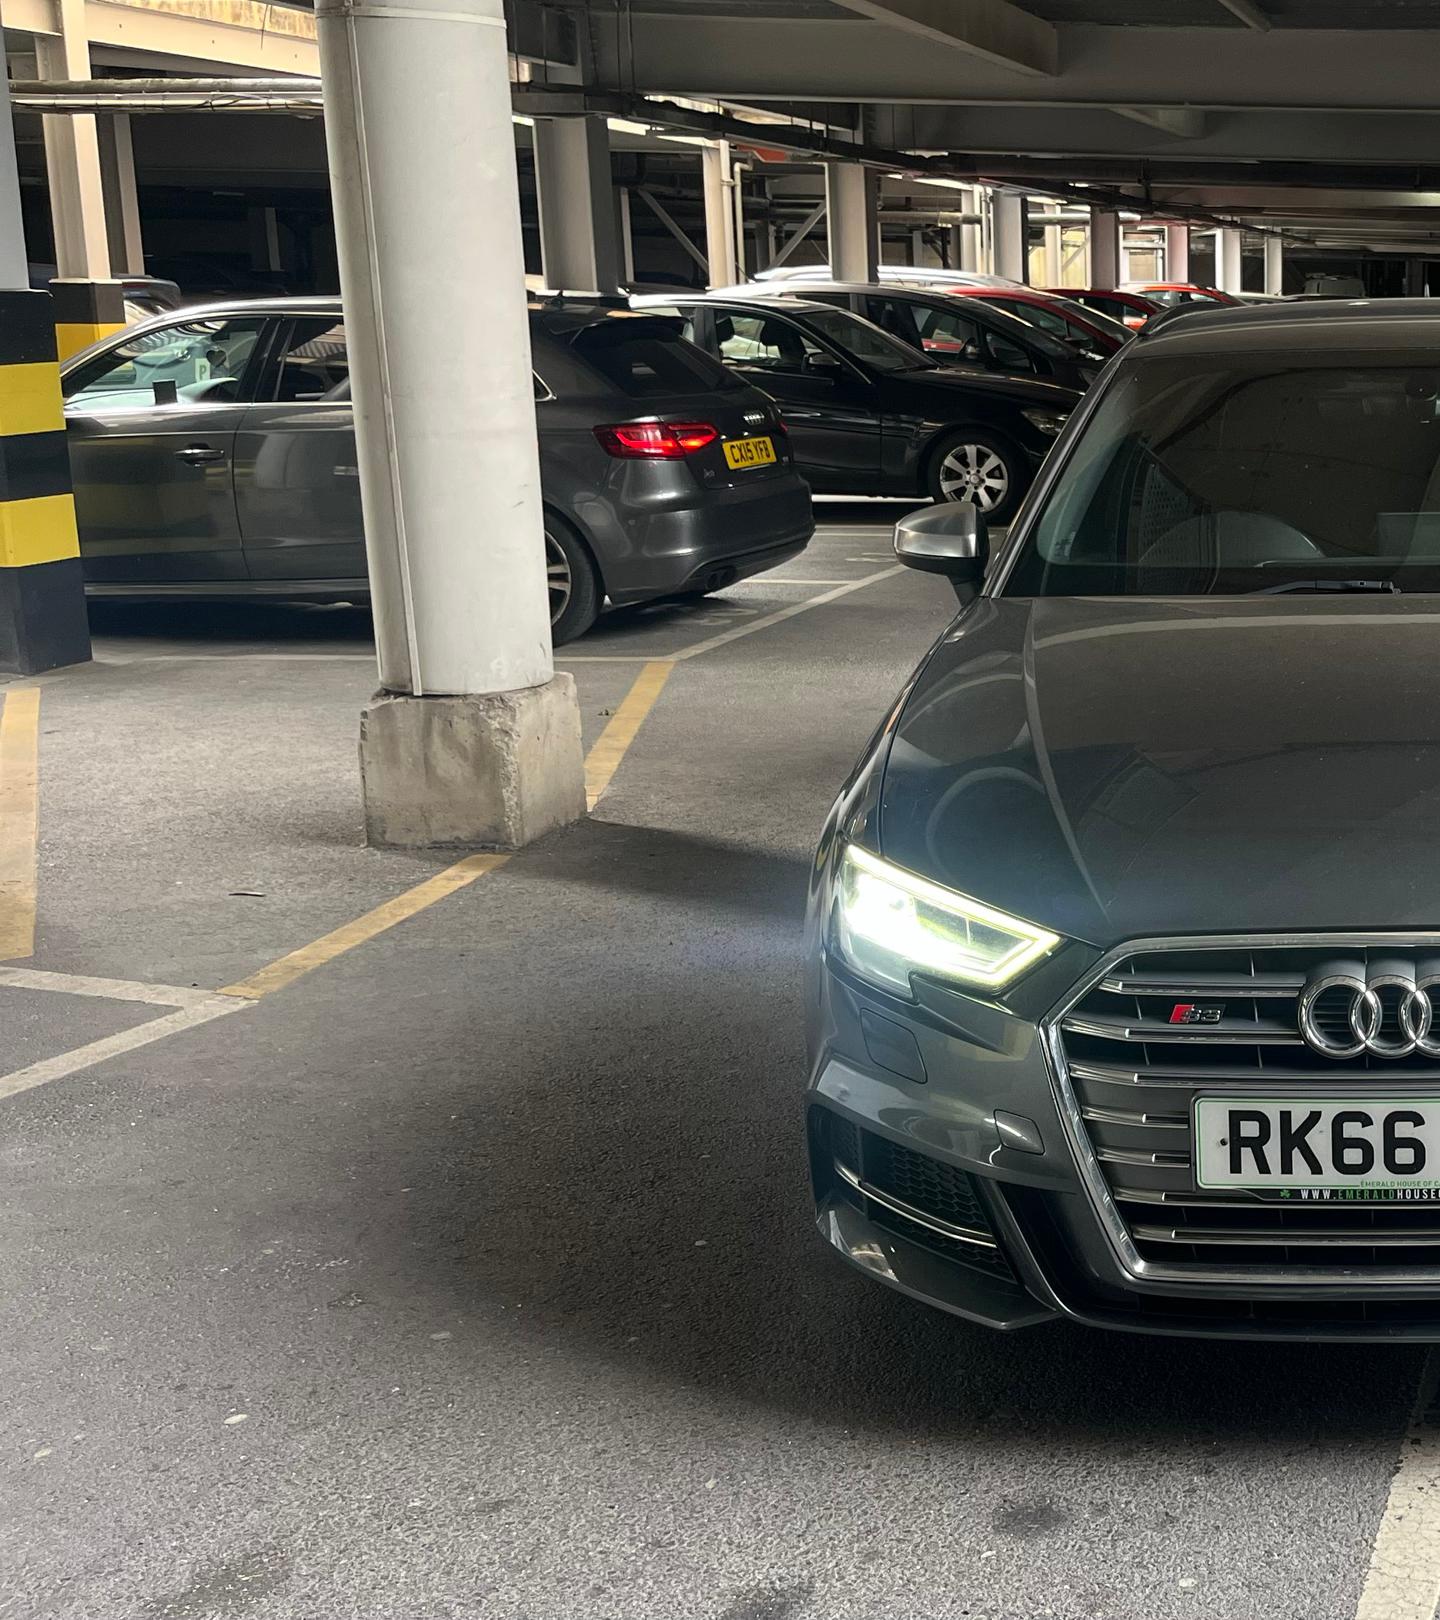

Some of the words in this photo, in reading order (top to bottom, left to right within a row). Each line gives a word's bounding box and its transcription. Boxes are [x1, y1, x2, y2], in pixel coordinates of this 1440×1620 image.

[199, 364, 207, 380] P
[730, 443, 755, 464] CX15
[751, 440, 771, 459] YFB
[1180, 1008, 1222, 1022] S3
[1227, 1109, 1427, 1175] RK66
[1360, 1180, 1395, 1188] EMERALD
[1396, 1180, 1421, 1188] HOUSE
